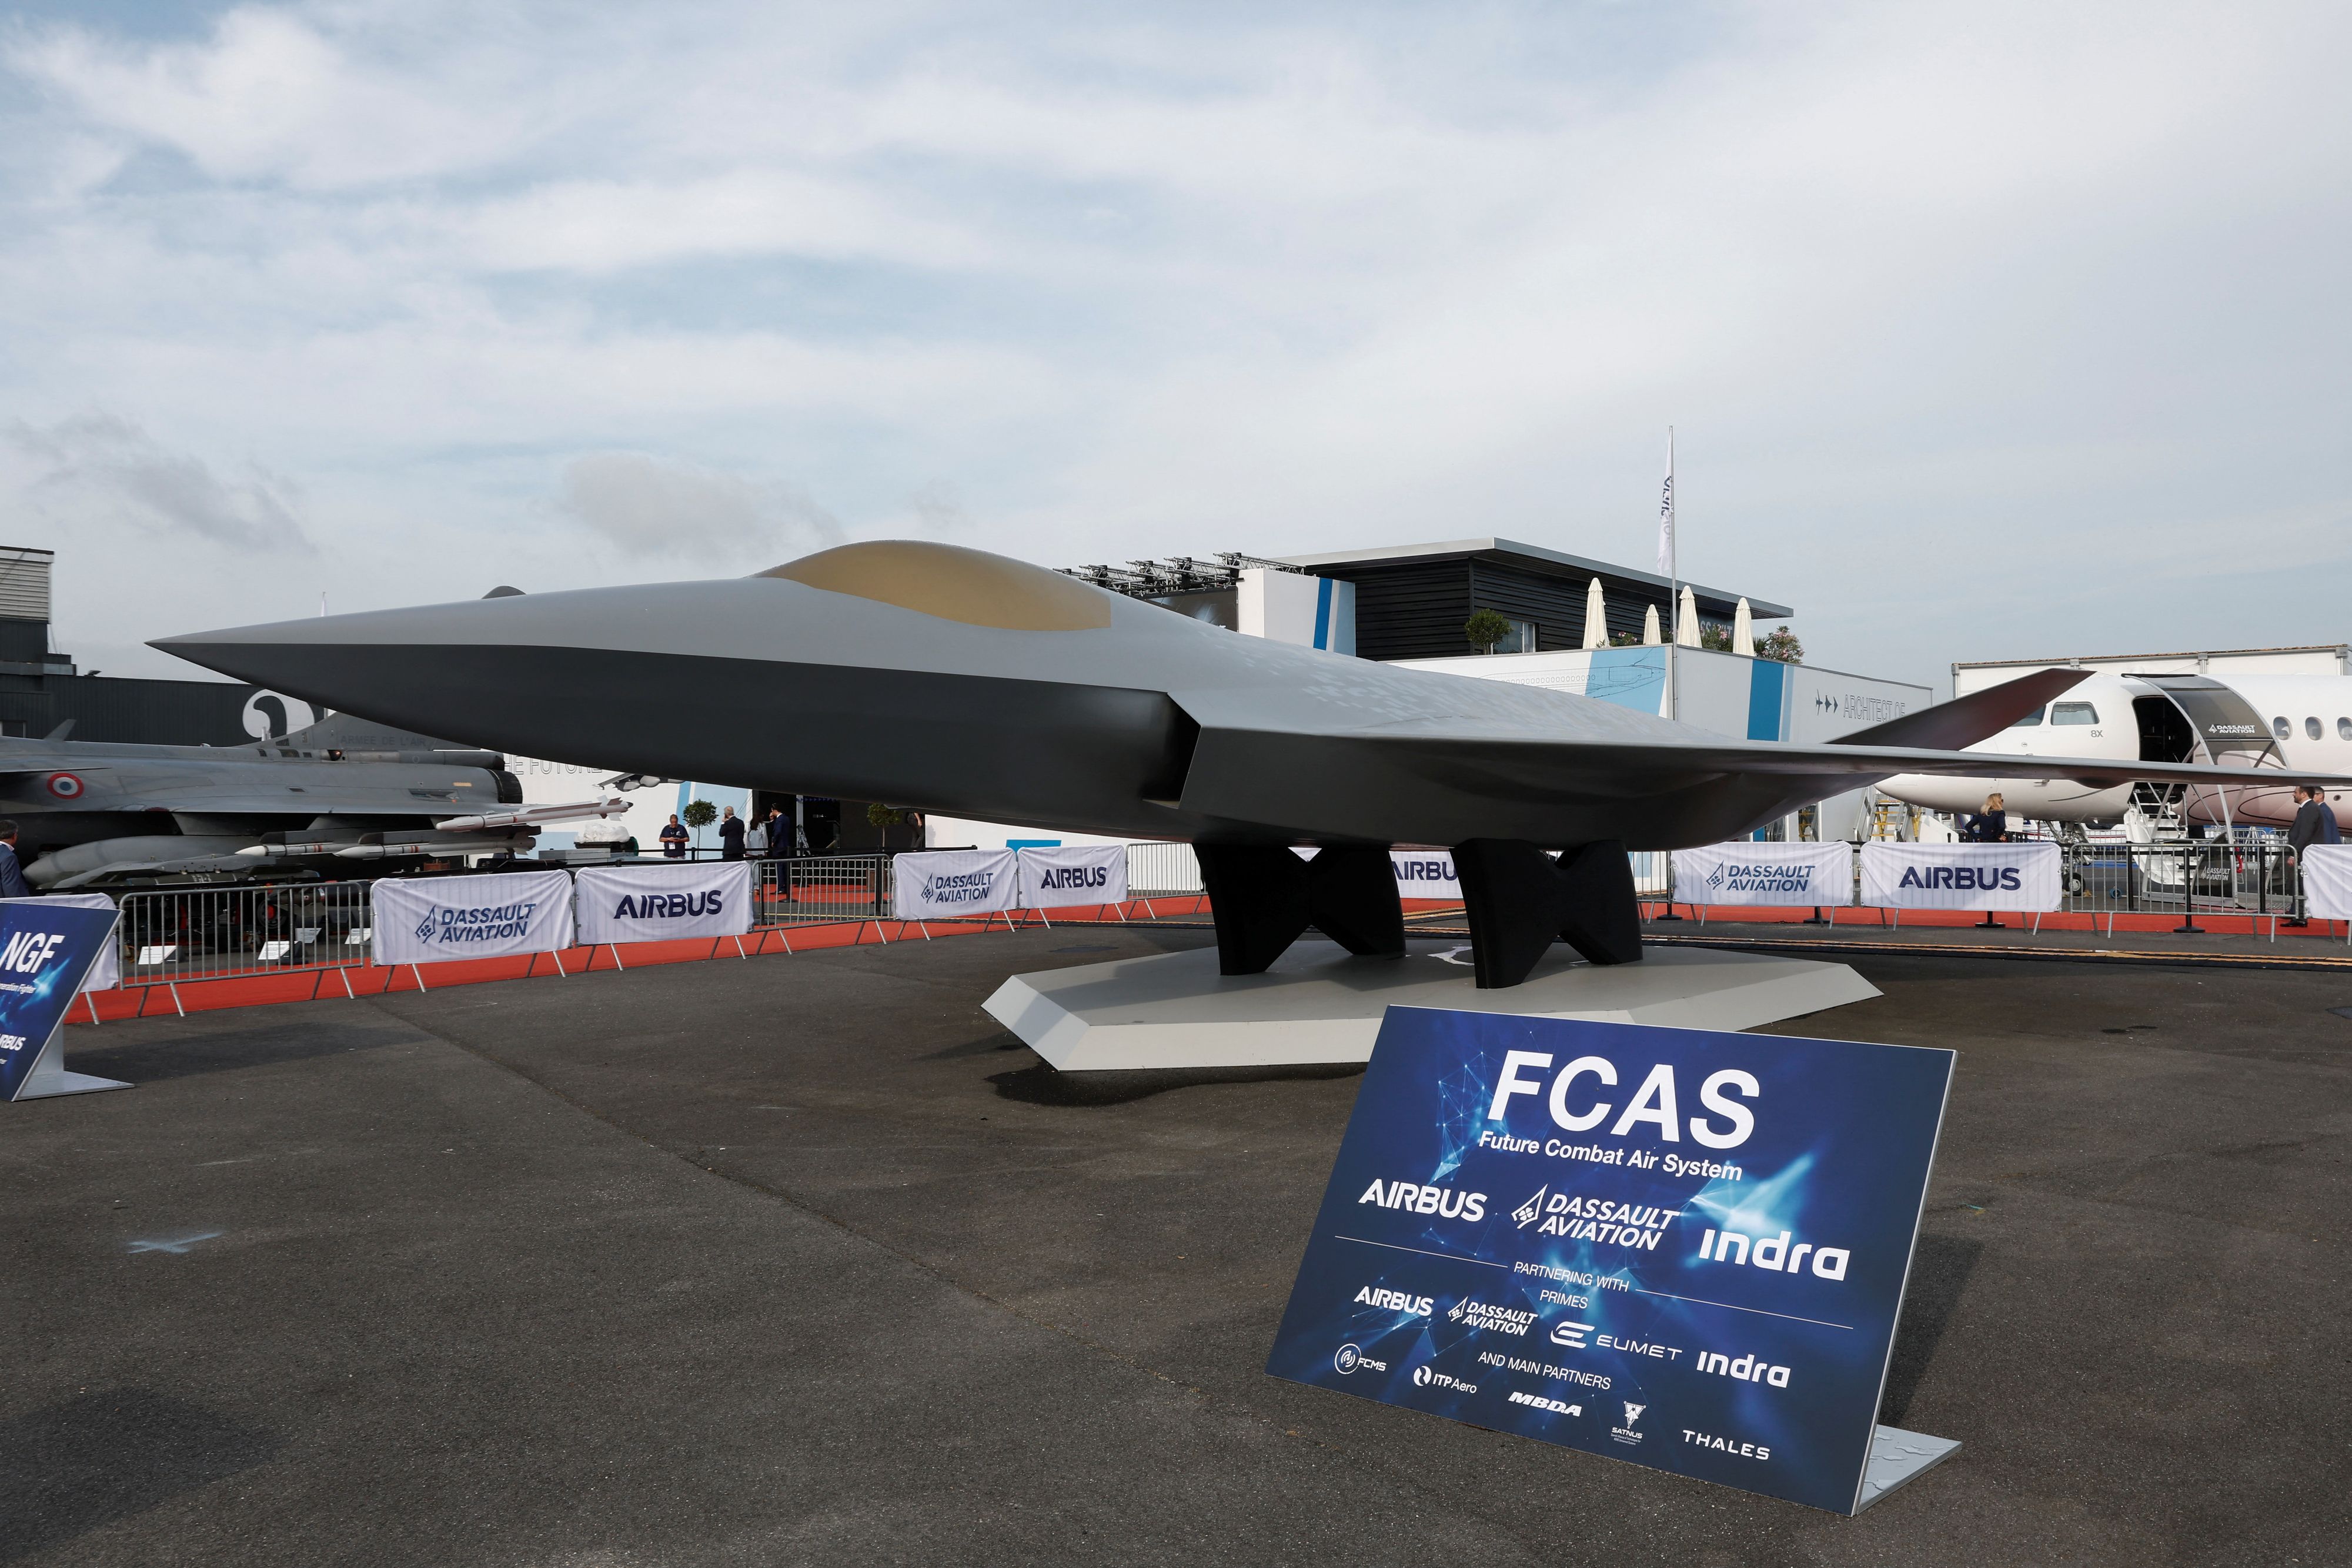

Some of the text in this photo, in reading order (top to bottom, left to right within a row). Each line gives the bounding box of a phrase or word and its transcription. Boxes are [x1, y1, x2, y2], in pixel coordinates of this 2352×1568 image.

[1843, 694, 1892, 722] ARCHITECT
[383, 736, 395, 745] DE
[2091, 730, 2103, 738] 8X
[935, 872, 994, 890] DASSAULT
[1040, 866, 1107, 890] AIRBUS
[1391, 861, 1458, 881] IRBU
[1728, 865, 1815, 878] DASSAULT
[1898, 866, 2021, 891] AIRBUS
[935, 887, 990, 903] AVIATION
[1726, 879, 1809, 891] AVIATION
[440, 904, 536, 925] DASSAULT
[613, 890, 722, 920] AIRBUS
[438, 921, 527, 942] AVIATION
[0, 931, 65, 974] NGF
[0, 1034, 26, 1051] RBUS
[1488, 1049, 1760, 1149] FCAS
[1478, 1131, 1742, 1181] Future Combat Air System
[1358, 1178, 1488, 1222] AIRBUS
[1546, 1193, 1680, 1230] DASSAULT
[1538, 1215, 1663, 1251] AVIATION
[1514, 1262, 1629, 1292] PARTNERING WITH
[1354, 1286, 1434, 1316] AIRBUS
[1539, 1289, 1588, 1309] PRIMES
[1462, 1314, 1529, 1336] AVIATION
[1466, 1302, 1538, 1325] DASSAULT
[1596, 1334, 1682, 1360] EUMET
[1357, 1357, 1387, 1372] FCMS
[1478, 1352, 1611, 1390] AND MAIN PARTNERS
[1508, 1392, 1582, 1417] MBDA
[1612, 1427, 1643, 1439] SATNUS
[1682, 1429, 1770, 1460] THALES
